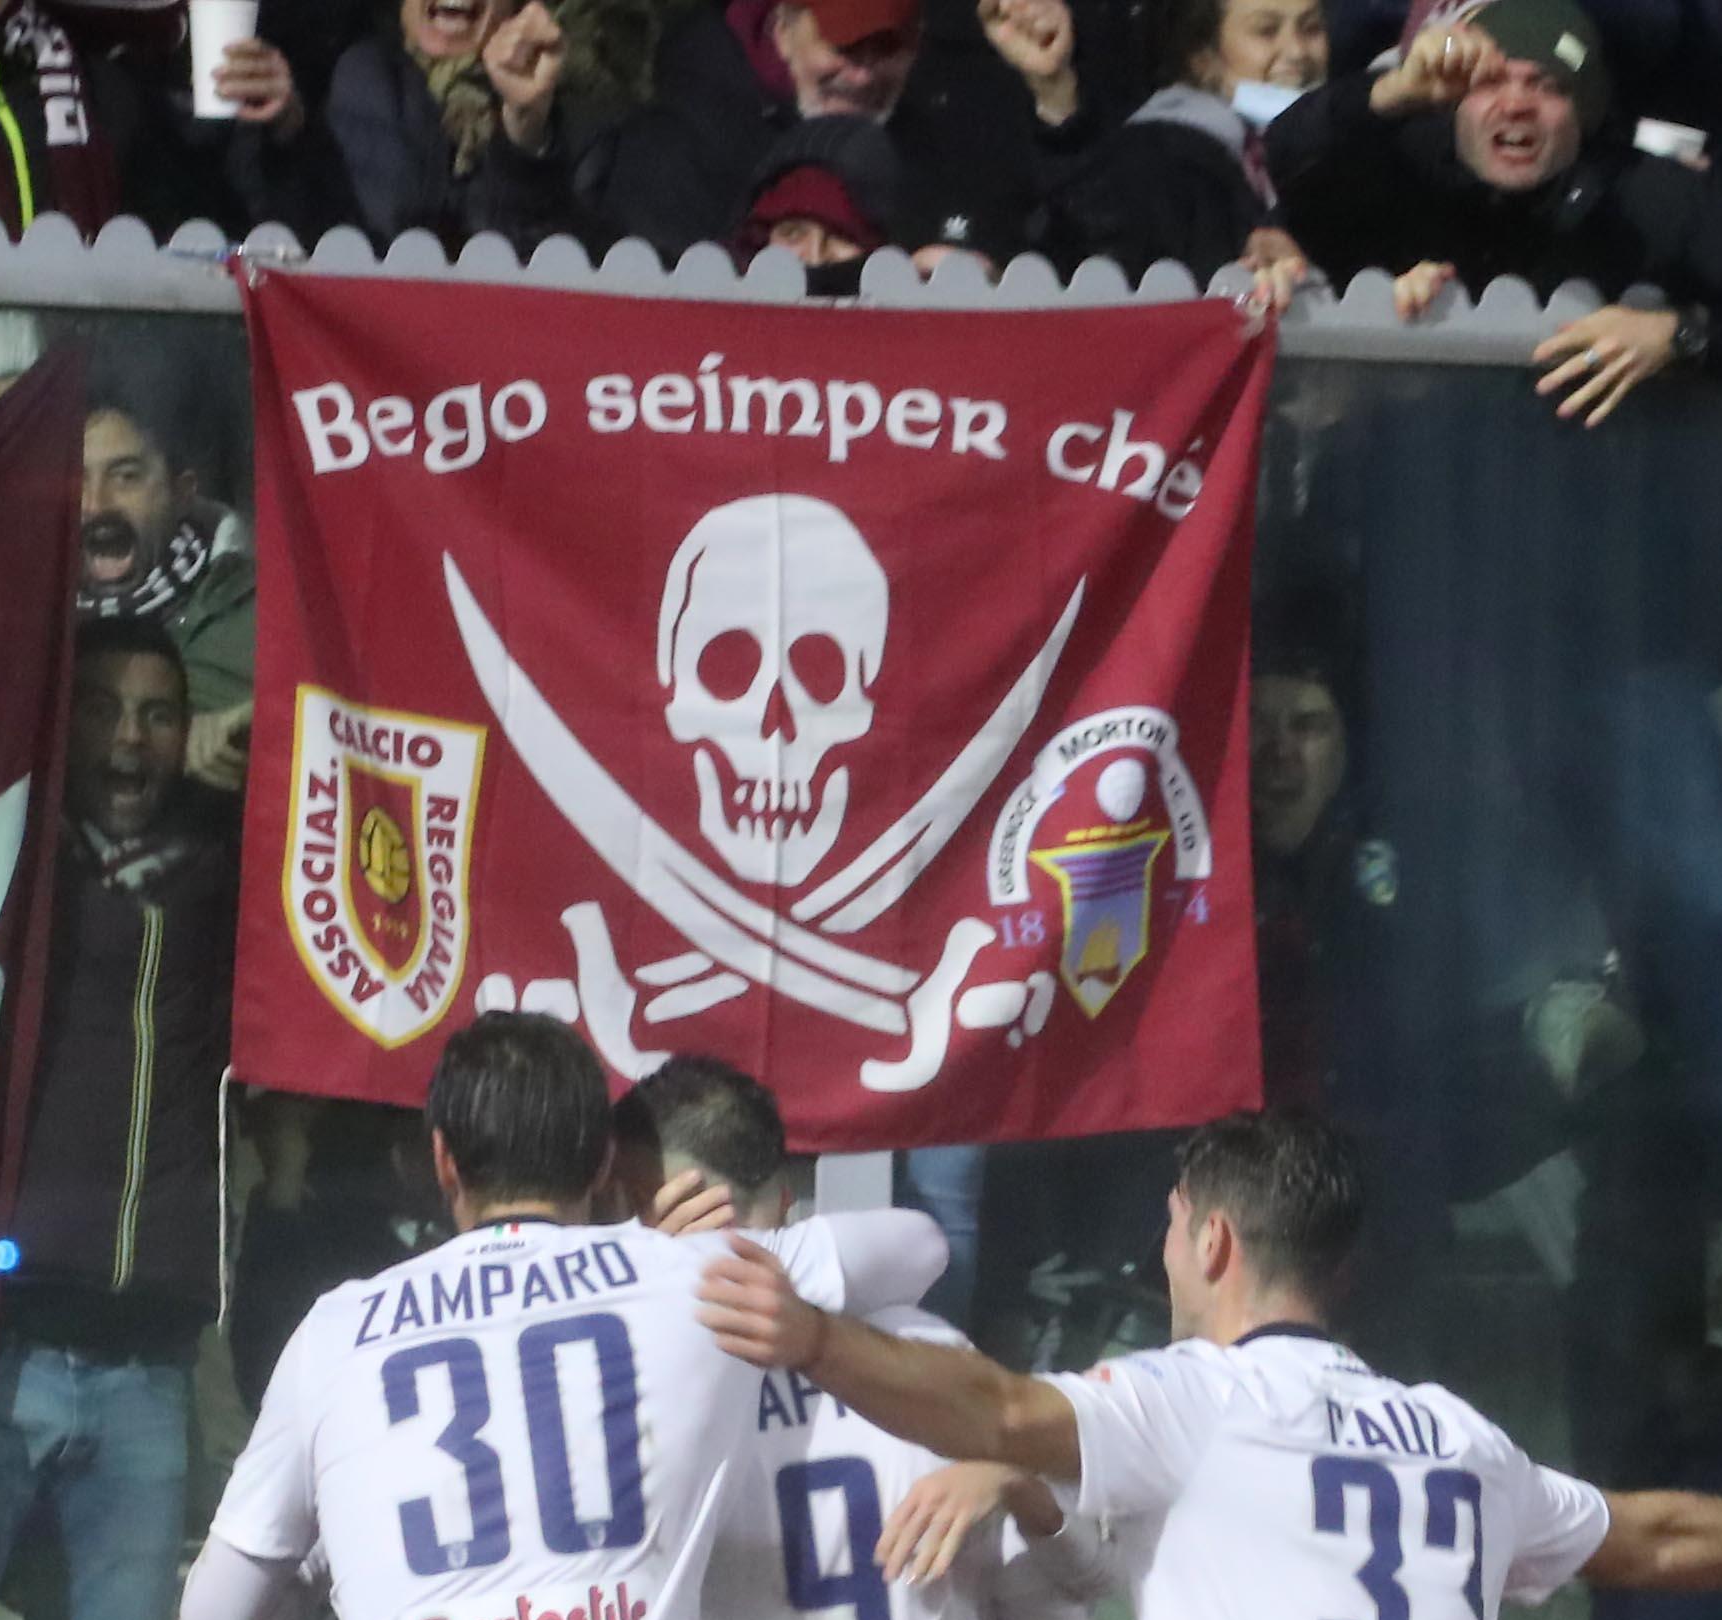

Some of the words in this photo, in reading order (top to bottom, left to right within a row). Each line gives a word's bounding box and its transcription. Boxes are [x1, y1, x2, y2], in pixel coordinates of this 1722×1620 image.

[293, 378, 547, 475] Bego
[329, 709, 443, 768] CALCIO
[1058, 717, 1169, 764] MORTON
[302, 758, 385, 1005] ASSOCIAZ.
[404, 794, 459, 1013] REGGIANA
[1001, 910, 1046, 949] 18
[354, 1241, 638, 1348] ZAMPARO
[381, 1313, 646, 1576] 30
